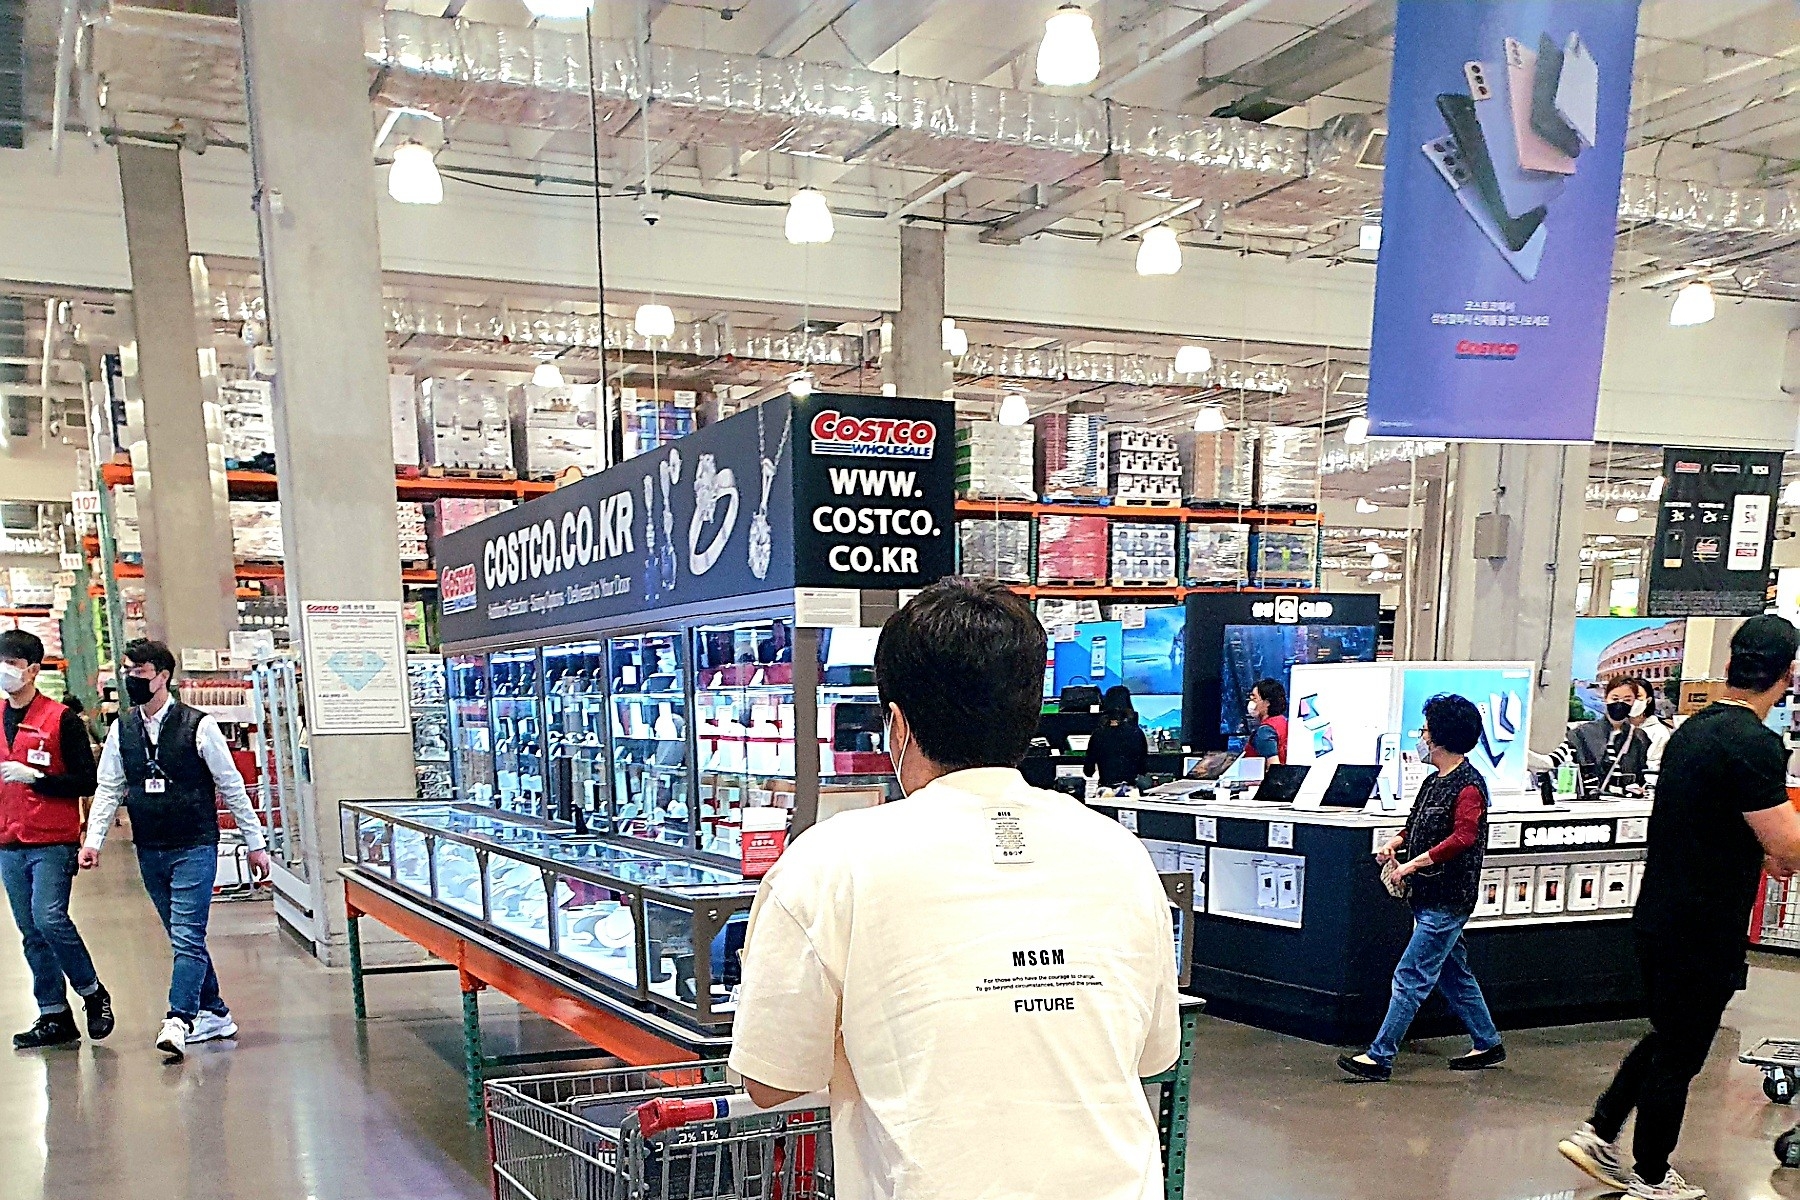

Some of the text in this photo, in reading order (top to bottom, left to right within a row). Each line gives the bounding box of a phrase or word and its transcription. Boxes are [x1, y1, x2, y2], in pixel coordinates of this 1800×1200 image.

[812, 411, 936, 446] COSTCO
[851, 444, 931, 457] WHOLESALE
[828, 467, 923, 498] WWW.
[75, 496, 98, 511] 107
[812, 506, 941, 537] COSTCO.
[483, 490, 636, 591] COSTCO.CO.KR
[828, 545, 919, 574] CO.KR
[306, 604, 339, 612] COSTCO
[1523, 824, 1612, 847] SAMSUNG
[1012, 949, 1065, 967] MSGM
[1014, 997, 1075, 1013] FUTURE
